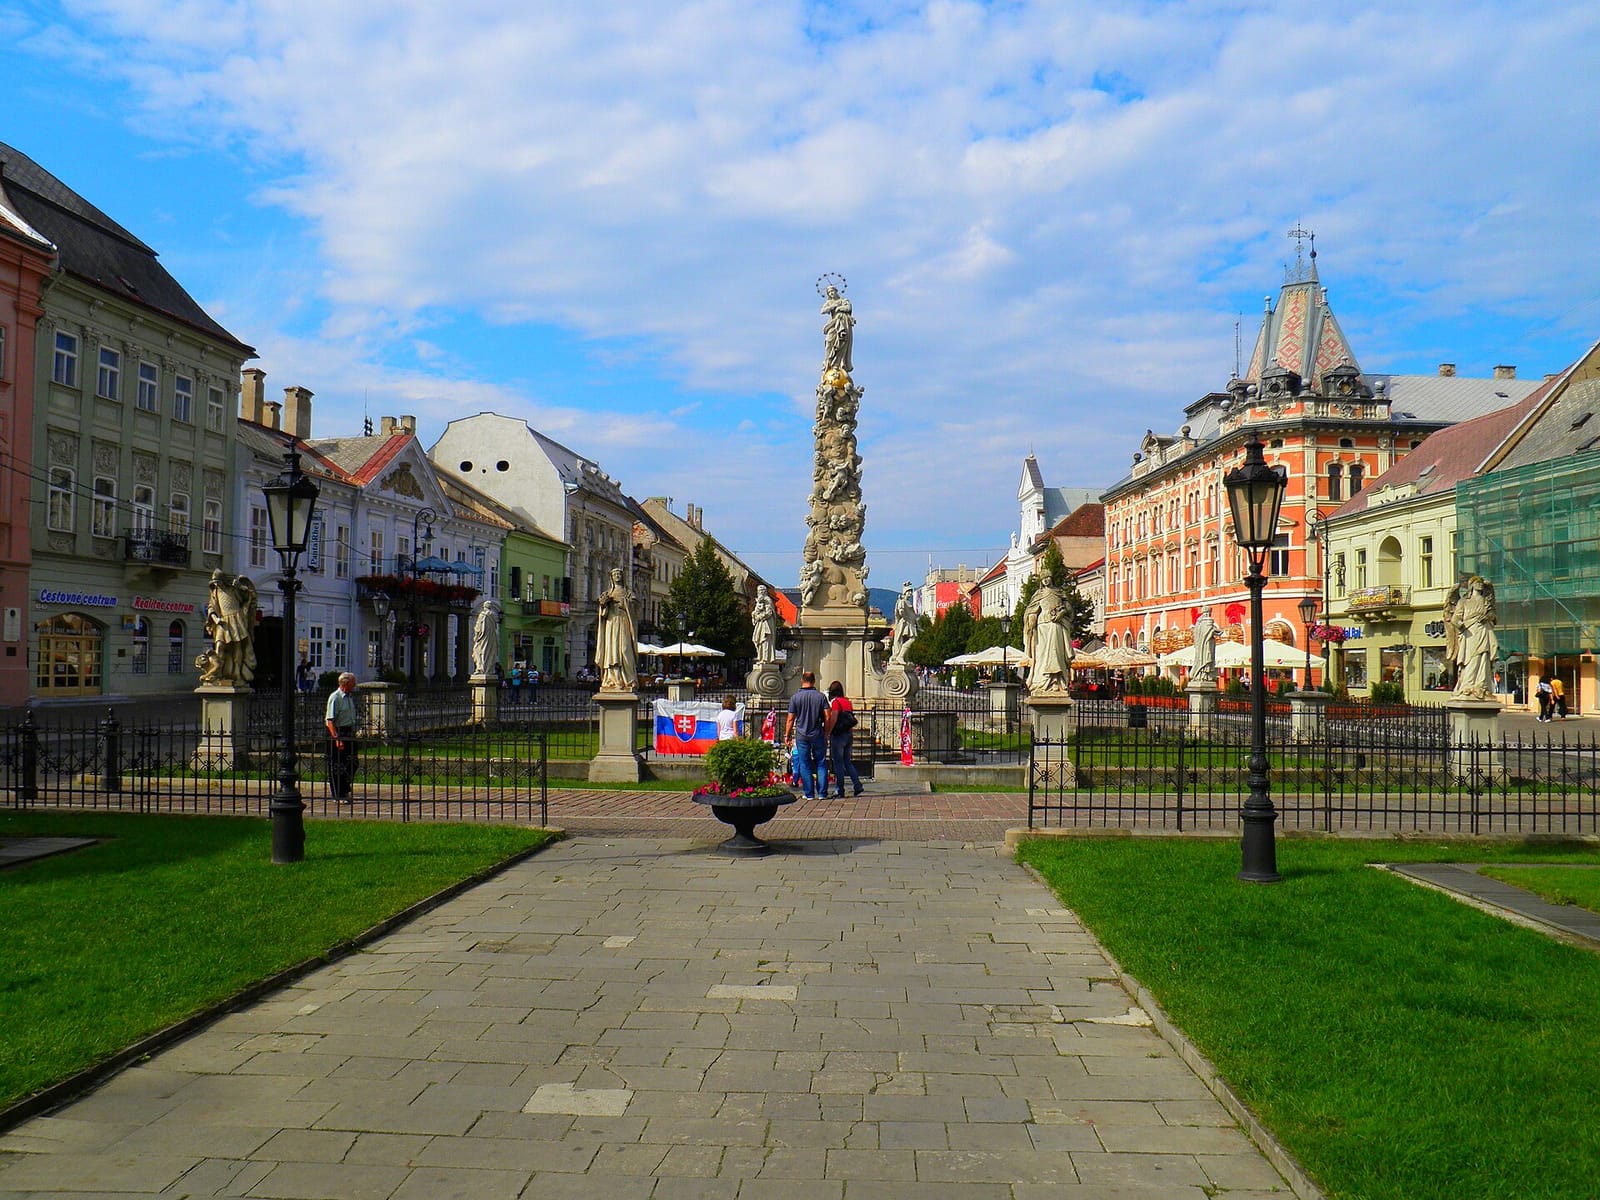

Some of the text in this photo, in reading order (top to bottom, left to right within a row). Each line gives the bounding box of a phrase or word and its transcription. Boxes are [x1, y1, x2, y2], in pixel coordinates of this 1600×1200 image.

[40, 588, 117, 606] Cestovné centrum
[166, 601, 194, 613] centrum
